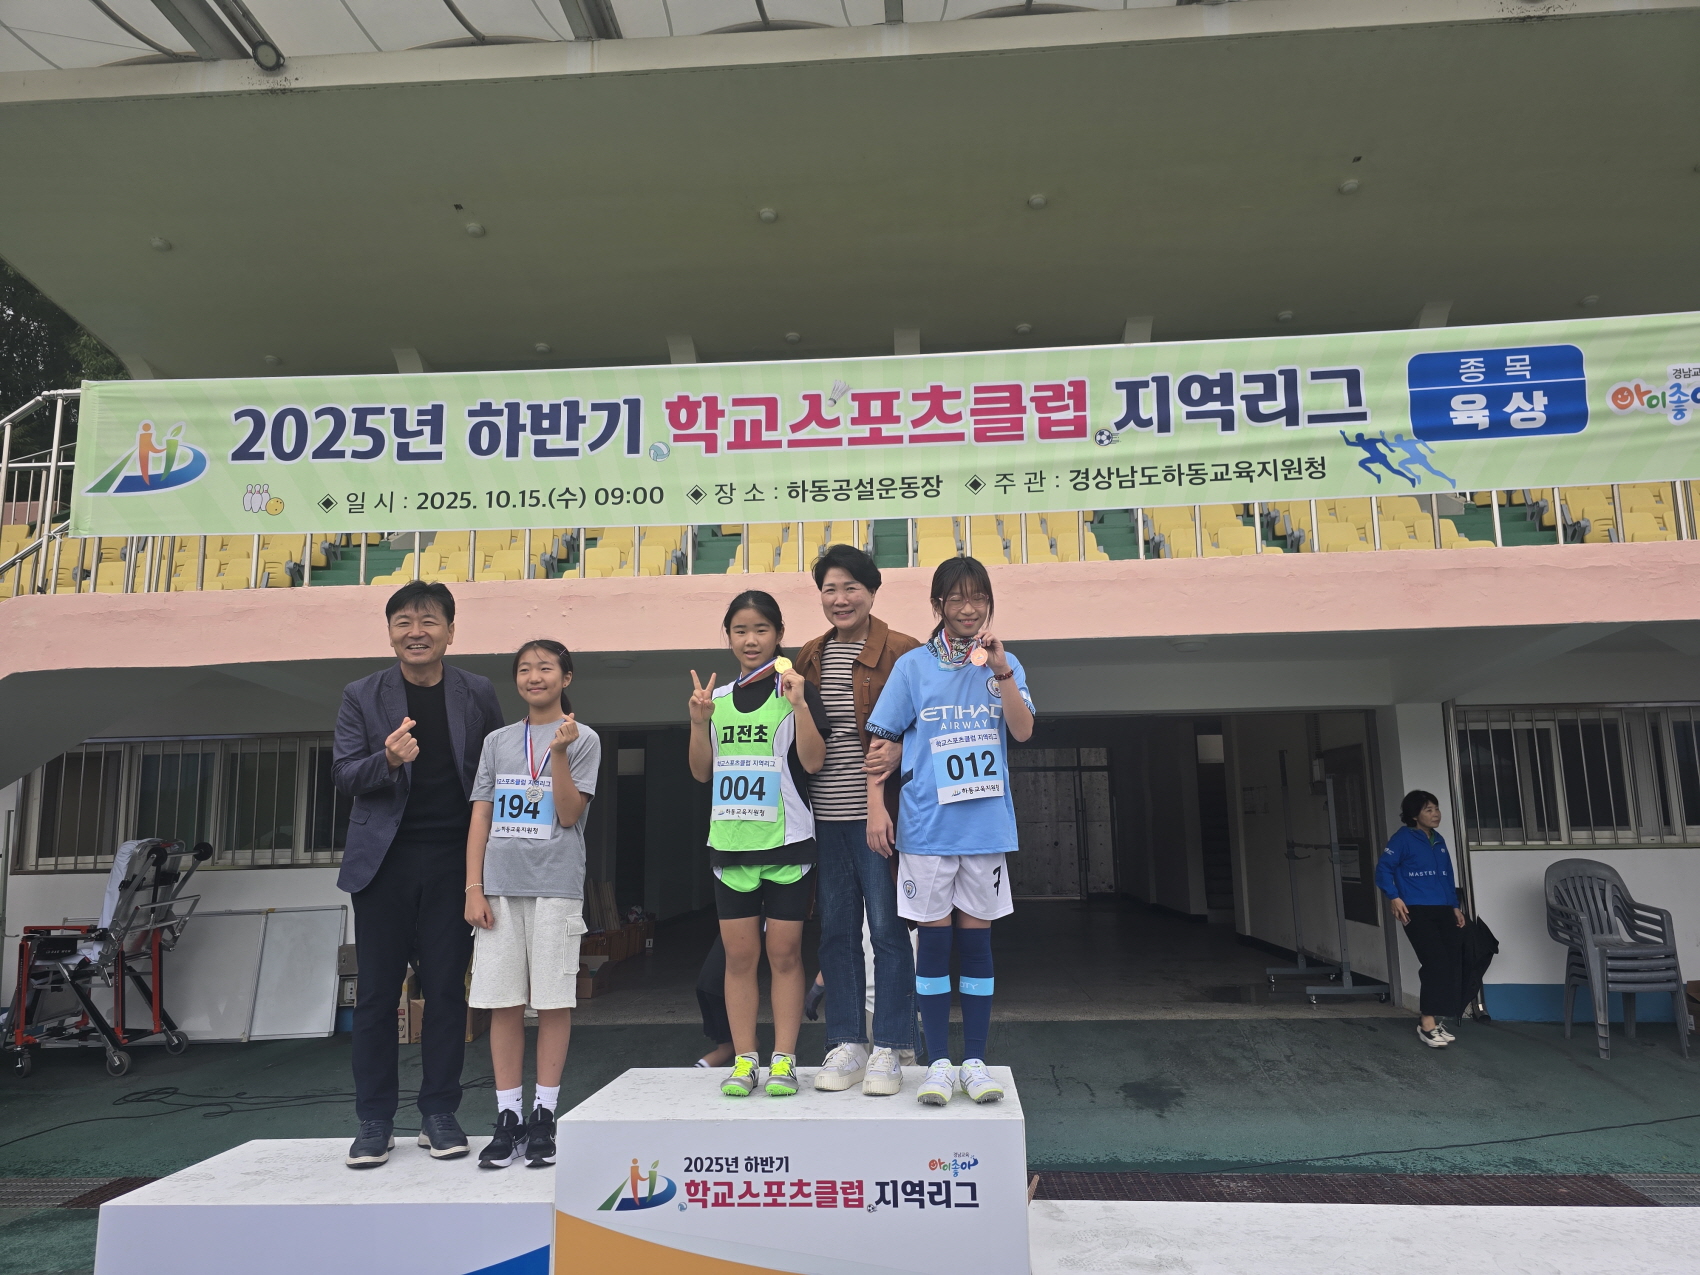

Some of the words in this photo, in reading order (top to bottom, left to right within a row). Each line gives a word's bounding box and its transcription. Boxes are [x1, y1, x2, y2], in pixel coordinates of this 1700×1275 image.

[230, 403, 444, 462] 2025년
[467, 398, 642, 459] 하반기
[664, 380, 1089, 455] 학교스포츠클럽
[1113, 368, 1369, 434] 지역리그
[1068, 456, 1328, 491] 경상남도하동교육지원청
[416, 491, 478, 510] 2025.
[485, 487, 587, 510] 10.15.(수)
[594, 486, 664, 506] 09:00
[787, 474, 944, 503] 하동공설운동장
[721, 724, 768, 745] 고전초
[936, 734, 976, 747] 학교스포츠클럽
[977, 733, 998, 742] 지역리그
[752, 759, 776, 767] 지역리그
[946, 750, 998, 781] 012
[719, 775, 766, 801] 004
[961, 784, 1000, 795] 하동교육지원청
[498, 794, 540, 820] 194
[725, 808, 765, 817] 하동교육지원청
[992, 865, 1001, 897] 7
[683, 1156, 739, 1174] 2025년
[744, 1156, 790, 1174] 하반기
[684, 1179, 865, 1210] 학교스포츠클럽
[875, 1179, 980, 1209] 지역리그
